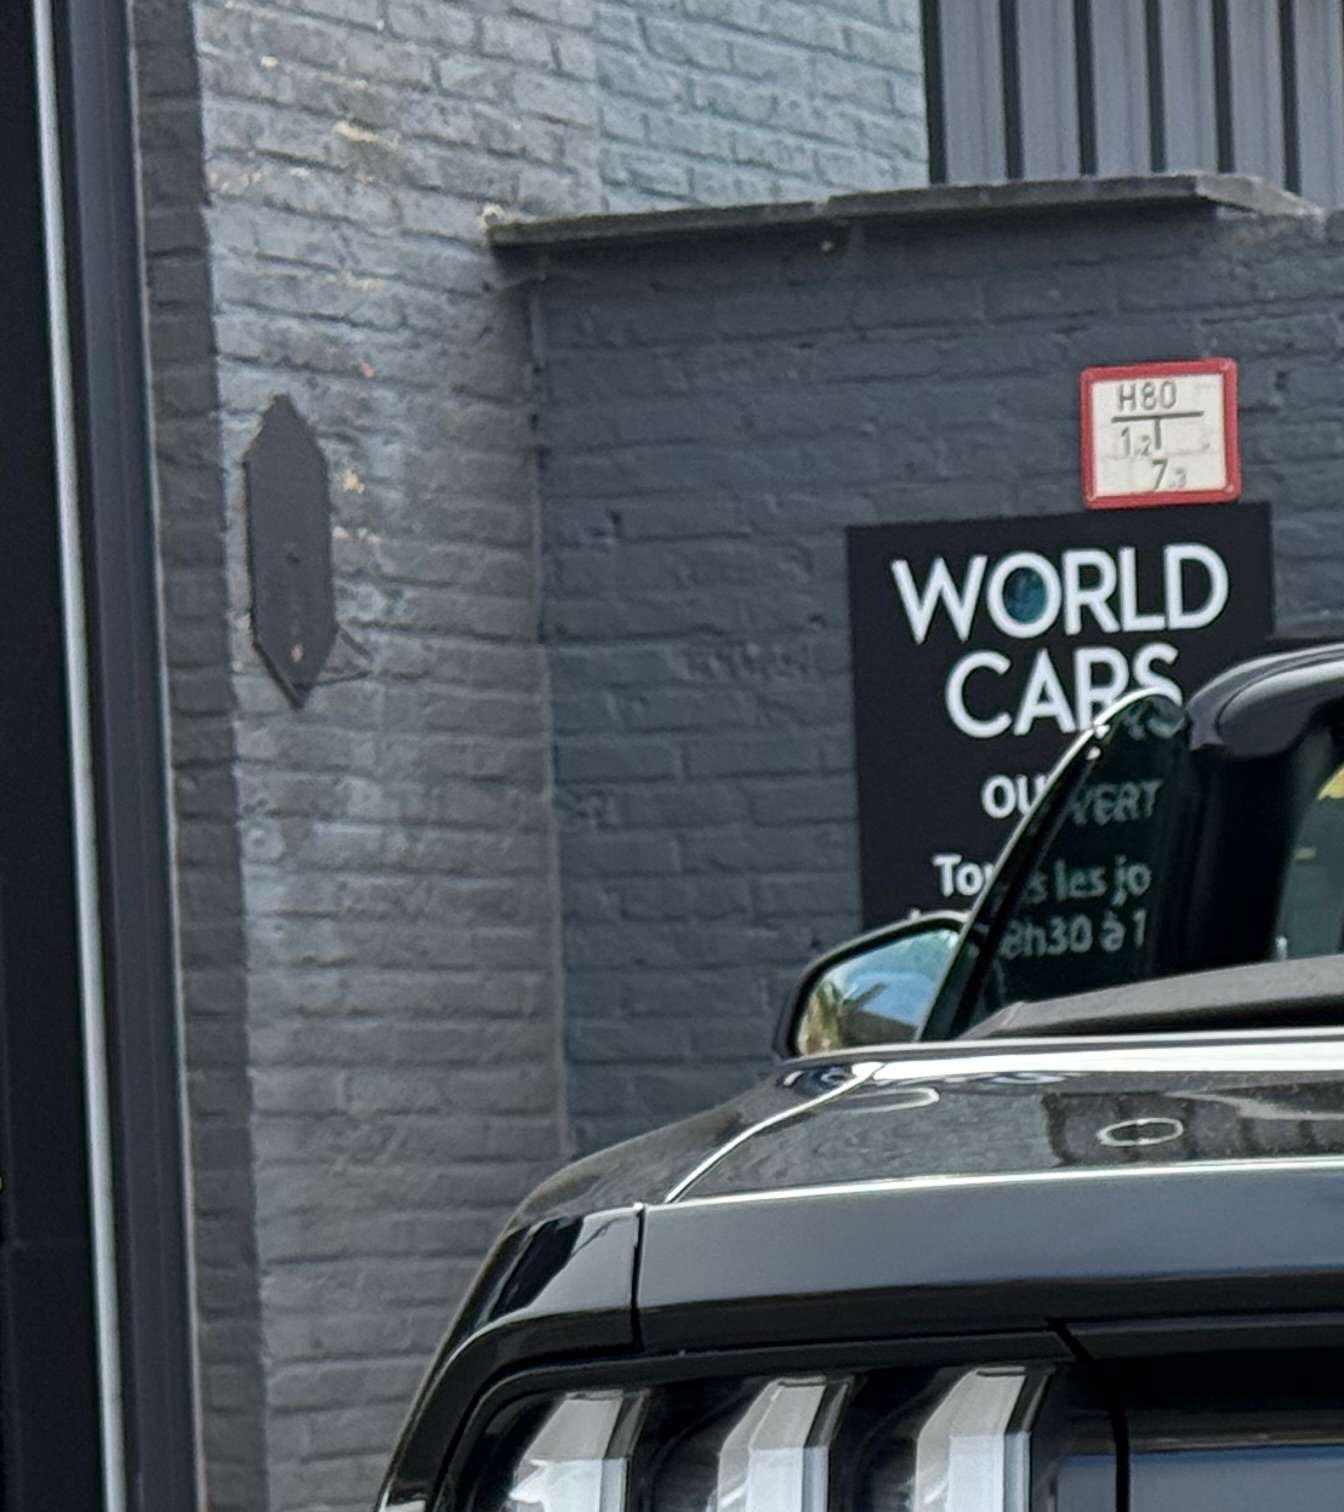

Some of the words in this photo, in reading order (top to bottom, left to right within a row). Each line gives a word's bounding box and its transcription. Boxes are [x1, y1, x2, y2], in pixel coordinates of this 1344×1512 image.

[1117, 380, 1178, 411] H80
[892, 544, 1230, 645] WORLD
[945, 642, 1184, 738] CARS
